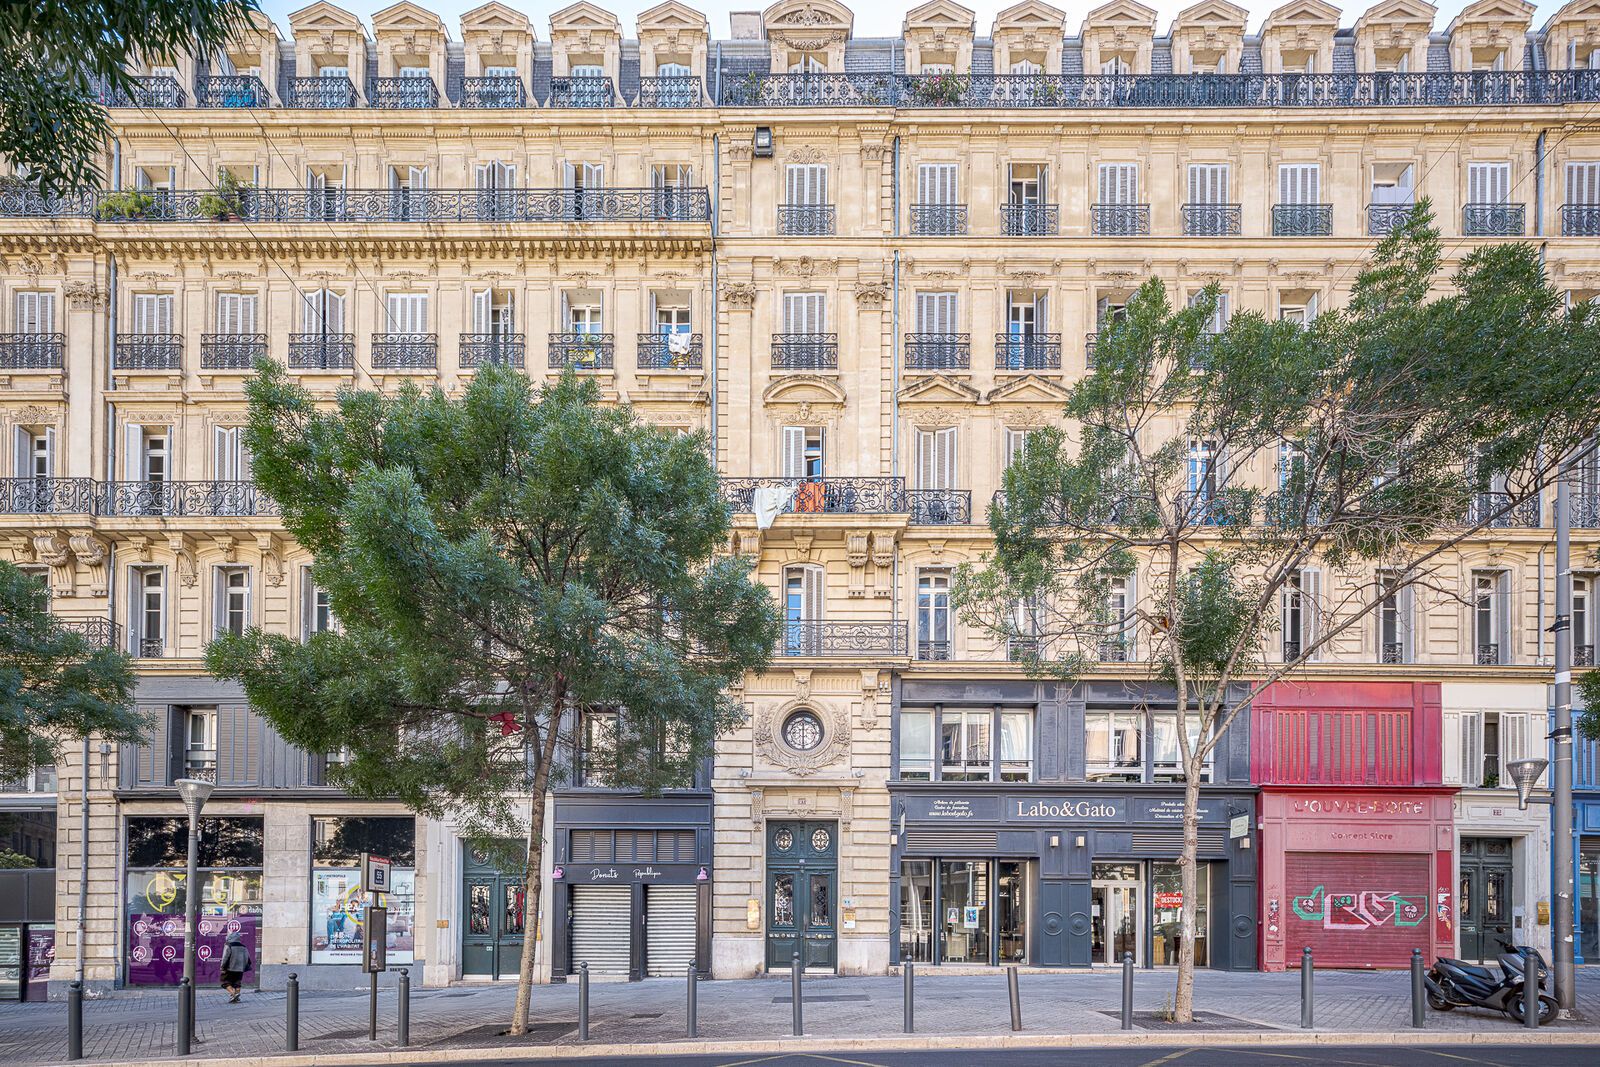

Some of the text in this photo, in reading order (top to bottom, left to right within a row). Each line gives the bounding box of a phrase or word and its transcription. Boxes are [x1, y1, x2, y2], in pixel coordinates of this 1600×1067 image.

[1017, 801, 1116, 817] Labo&Gato
[1370, 832, 1393, 840] Store
[590, 868, 618, 880] Donuts
